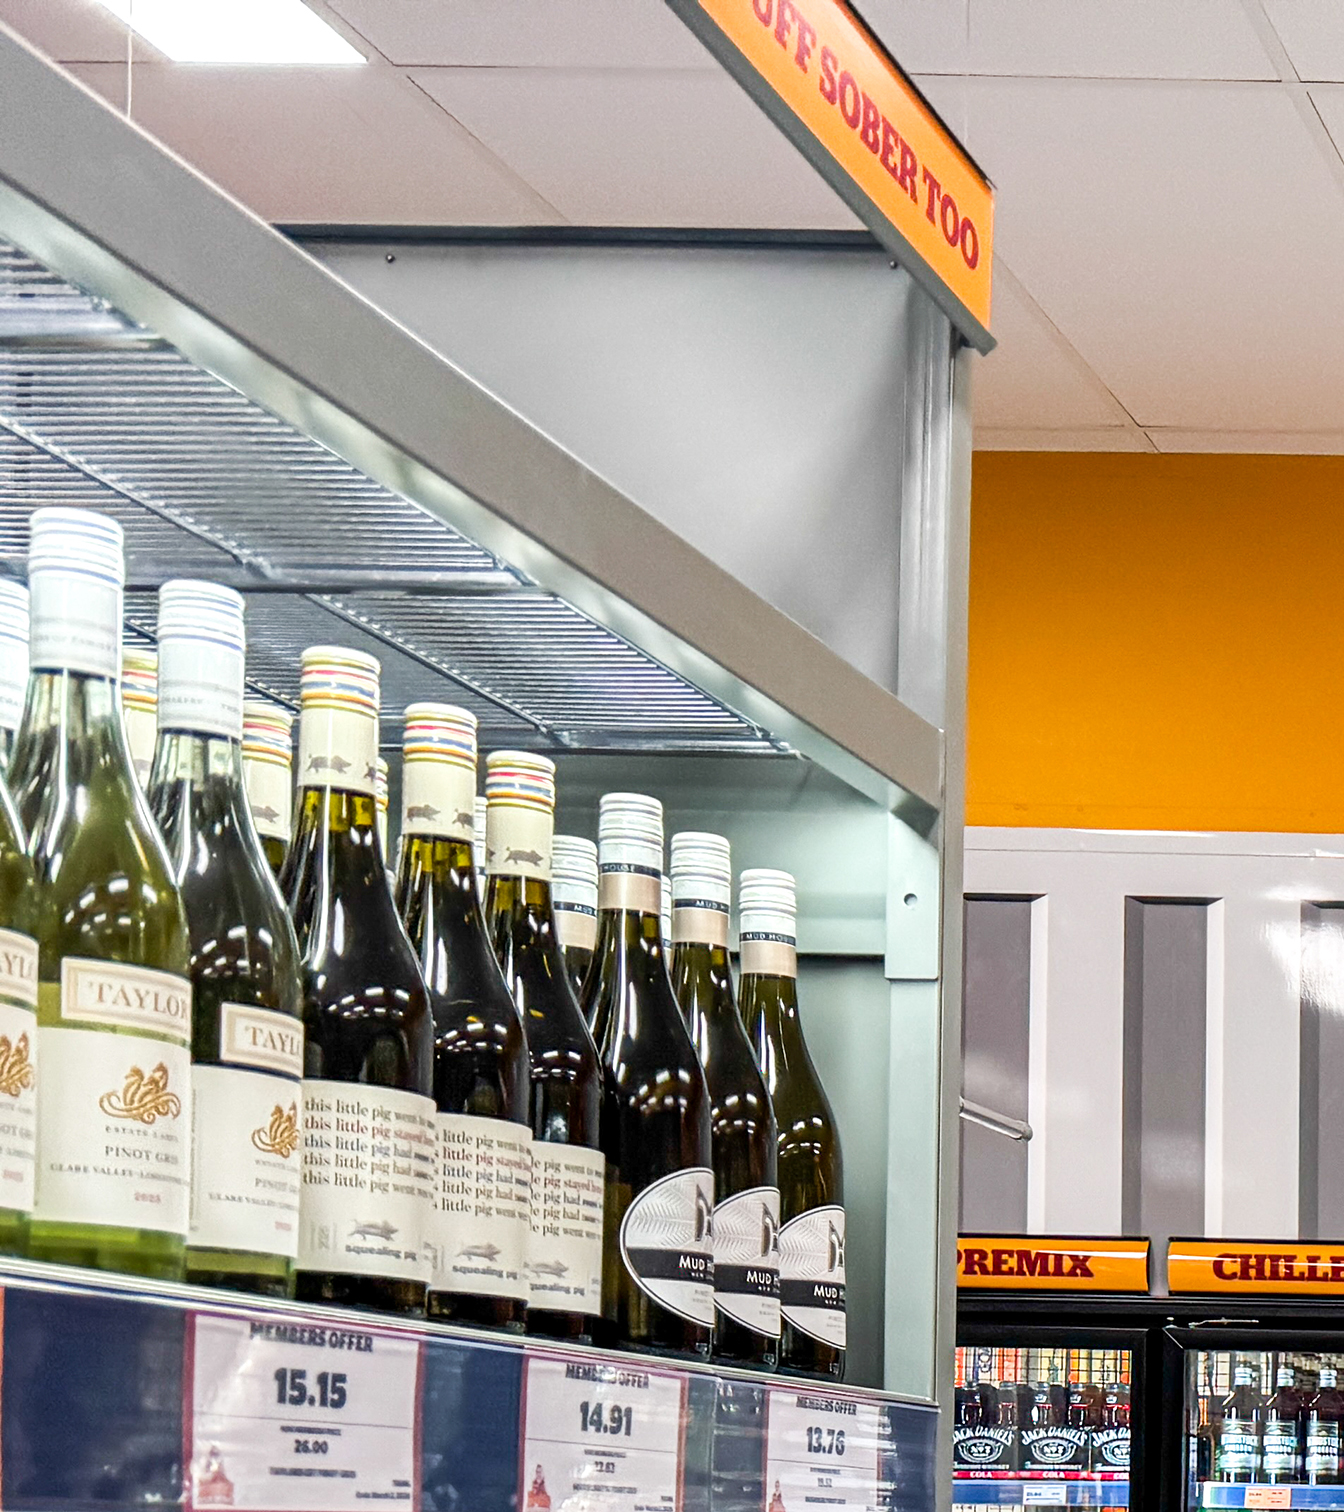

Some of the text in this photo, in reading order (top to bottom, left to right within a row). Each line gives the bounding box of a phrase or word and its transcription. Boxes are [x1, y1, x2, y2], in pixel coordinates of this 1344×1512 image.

[819, 46, 918, 204] SOBER
[922, 165, 979, 270] TOO
[305, 1098, 391, 1122] this little pig
[305, 1115, 391, 1139] this little pig
[104, 1145, 152, 1161] PINOT
[304, 1134, 391, 1158] this little pig
[303, 1152, 390, 1177] this little pig
[303, 1170, 390, 1195] this little pig
[679, 1255, 706, 1271] MUD
[746, 1271, 773, 1285] MUD
[814, 1285, 838, 1299] MUD
[251, 1321, 374, 1353] MEMBERS OFFER
[274, 1367, 347, 1410] 15.15
[619, 1371, 650, 1390] OFFER
[580, 1401, 633, 1437] 14.91
[807, 1426, 846, 1457] 13.76
[1021, 1428, 1047, 1446] JACK
[1042, 1470, 1066, 1479] COLA
